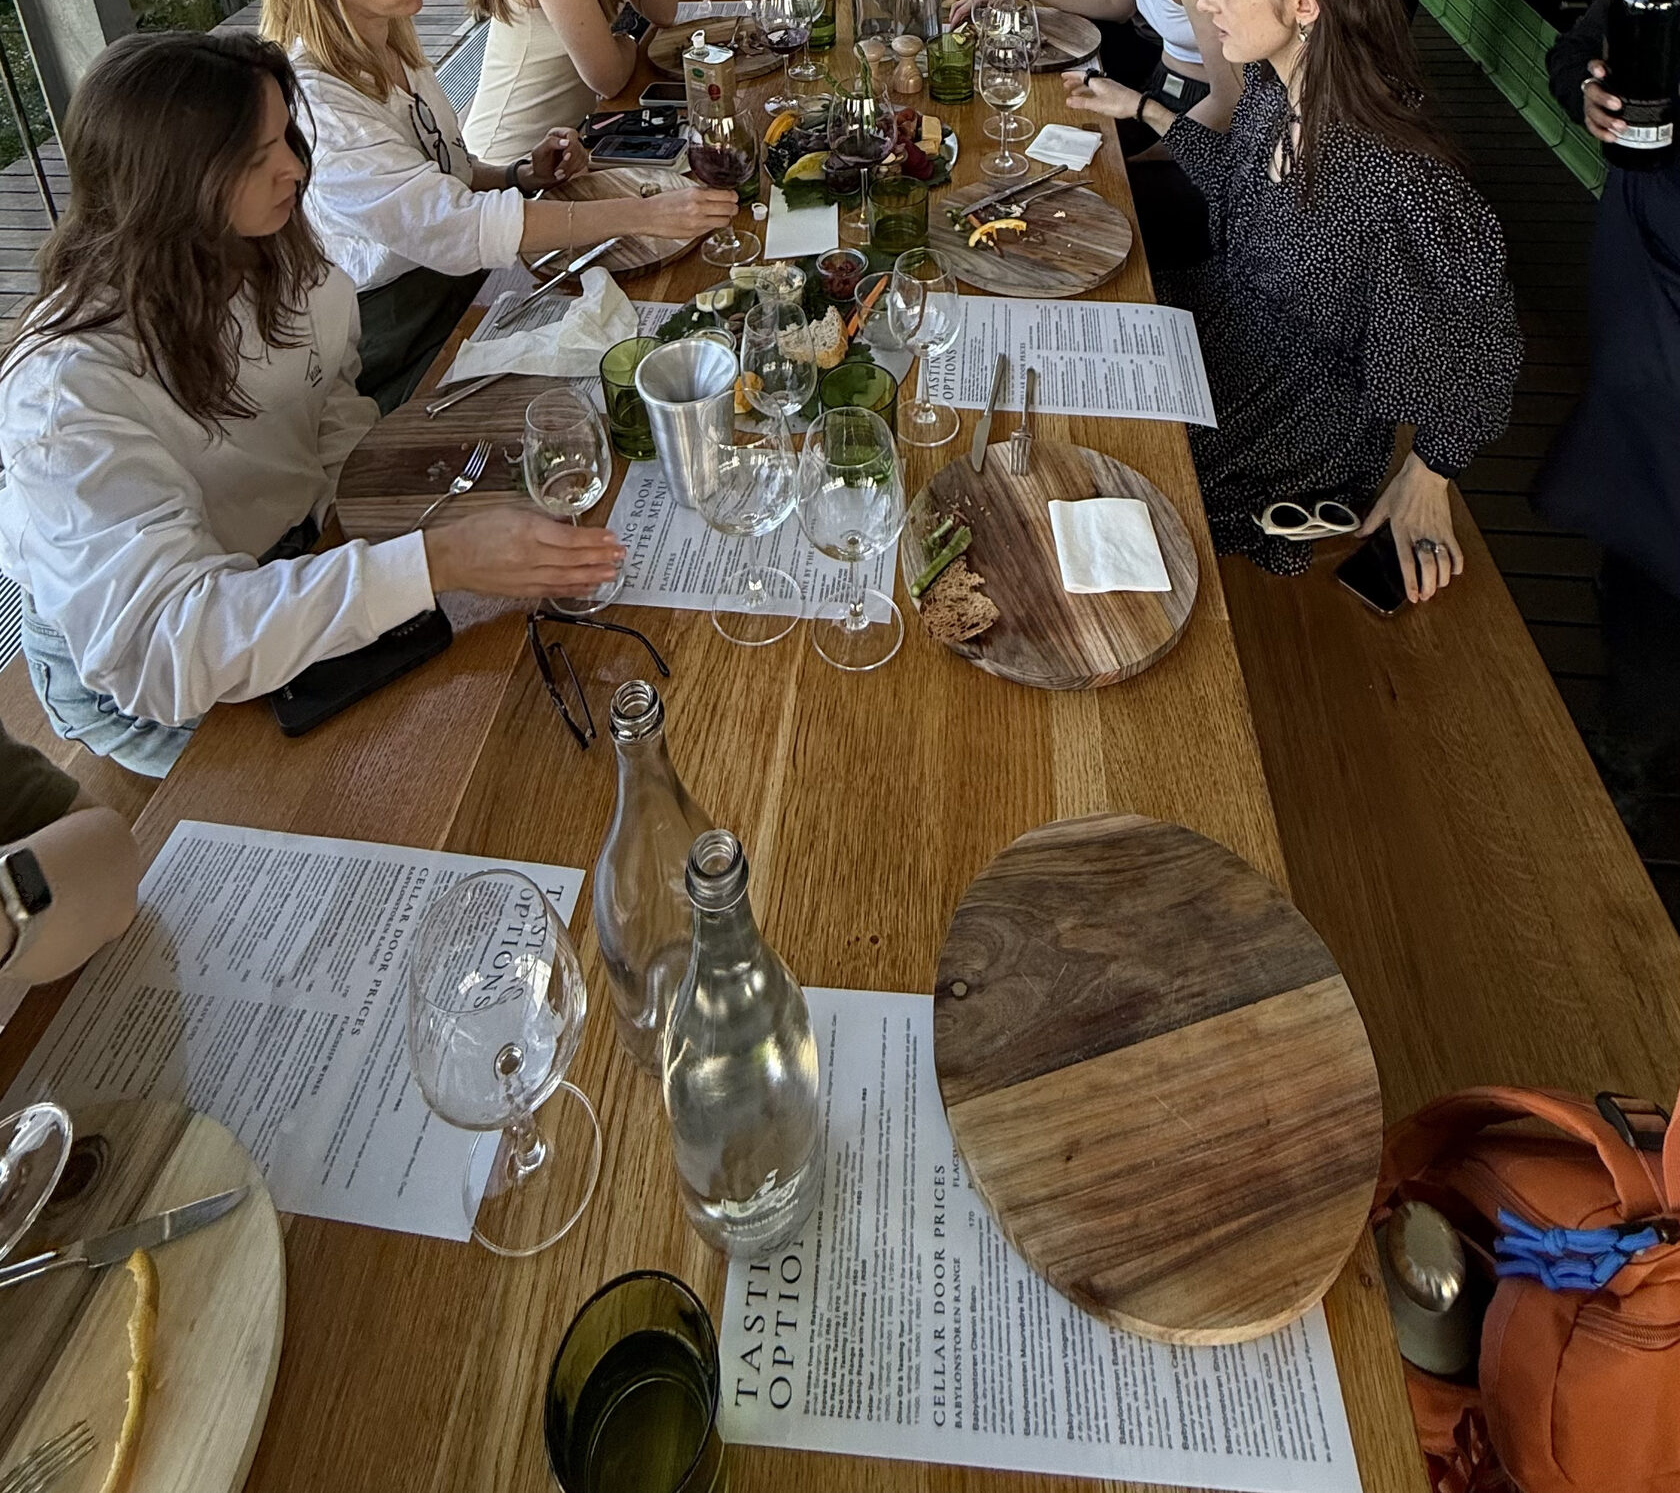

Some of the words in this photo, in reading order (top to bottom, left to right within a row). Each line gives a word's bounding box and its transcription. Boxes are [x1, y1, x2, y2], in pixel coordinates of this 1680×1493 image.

[929, 355, 941, 397] TASTIN
[943, 349, 956, 399] OPTIONS
[630, 478, 654, 517] ROOM
[623, 524, 655, 588] PLATTER
[660, 552, 676, 591] PLATTERS
[804, 568, 811, 577] BY
[806, 551, 814, 565] THE
[399, 868, 429, 923] CELLAR
[368, 936, 389, 965] RANGE
[378, 929, 404, 972] DOOR
[473, 888, 534, 1008] OPTIONS
[351, 979, 382, 1036] PRICES
[326, 1016, 350, 1062] FLAGSHIP
[311, 1065, 328, 1096] WINES
[952, 1146, 960, 1187] FLAGS
[934, 1164, 945, 1237] PRICES
[933, 1248, 945, 1315] DOOR
[953, 1257, 961, 1302] RANGE
[735, 1263, 770, 1406] TASTI
[769, 1240, 803, 1409] OPTIO
[933, 1326, 946, 1427] CELLAR
[954, 1305, 962, 1429] BABYLONSTOREN
[1212, 1345, 1220, 1372] Shira
[972, 1354, 980, 1431] Babylonstoren
[1022, 1361, 1030, 1436] Babylonstoren
[1064, 1363, 1074, 1440] Babylonstoren
[1114, 1369, 1126, 1444] Babylonstoren
